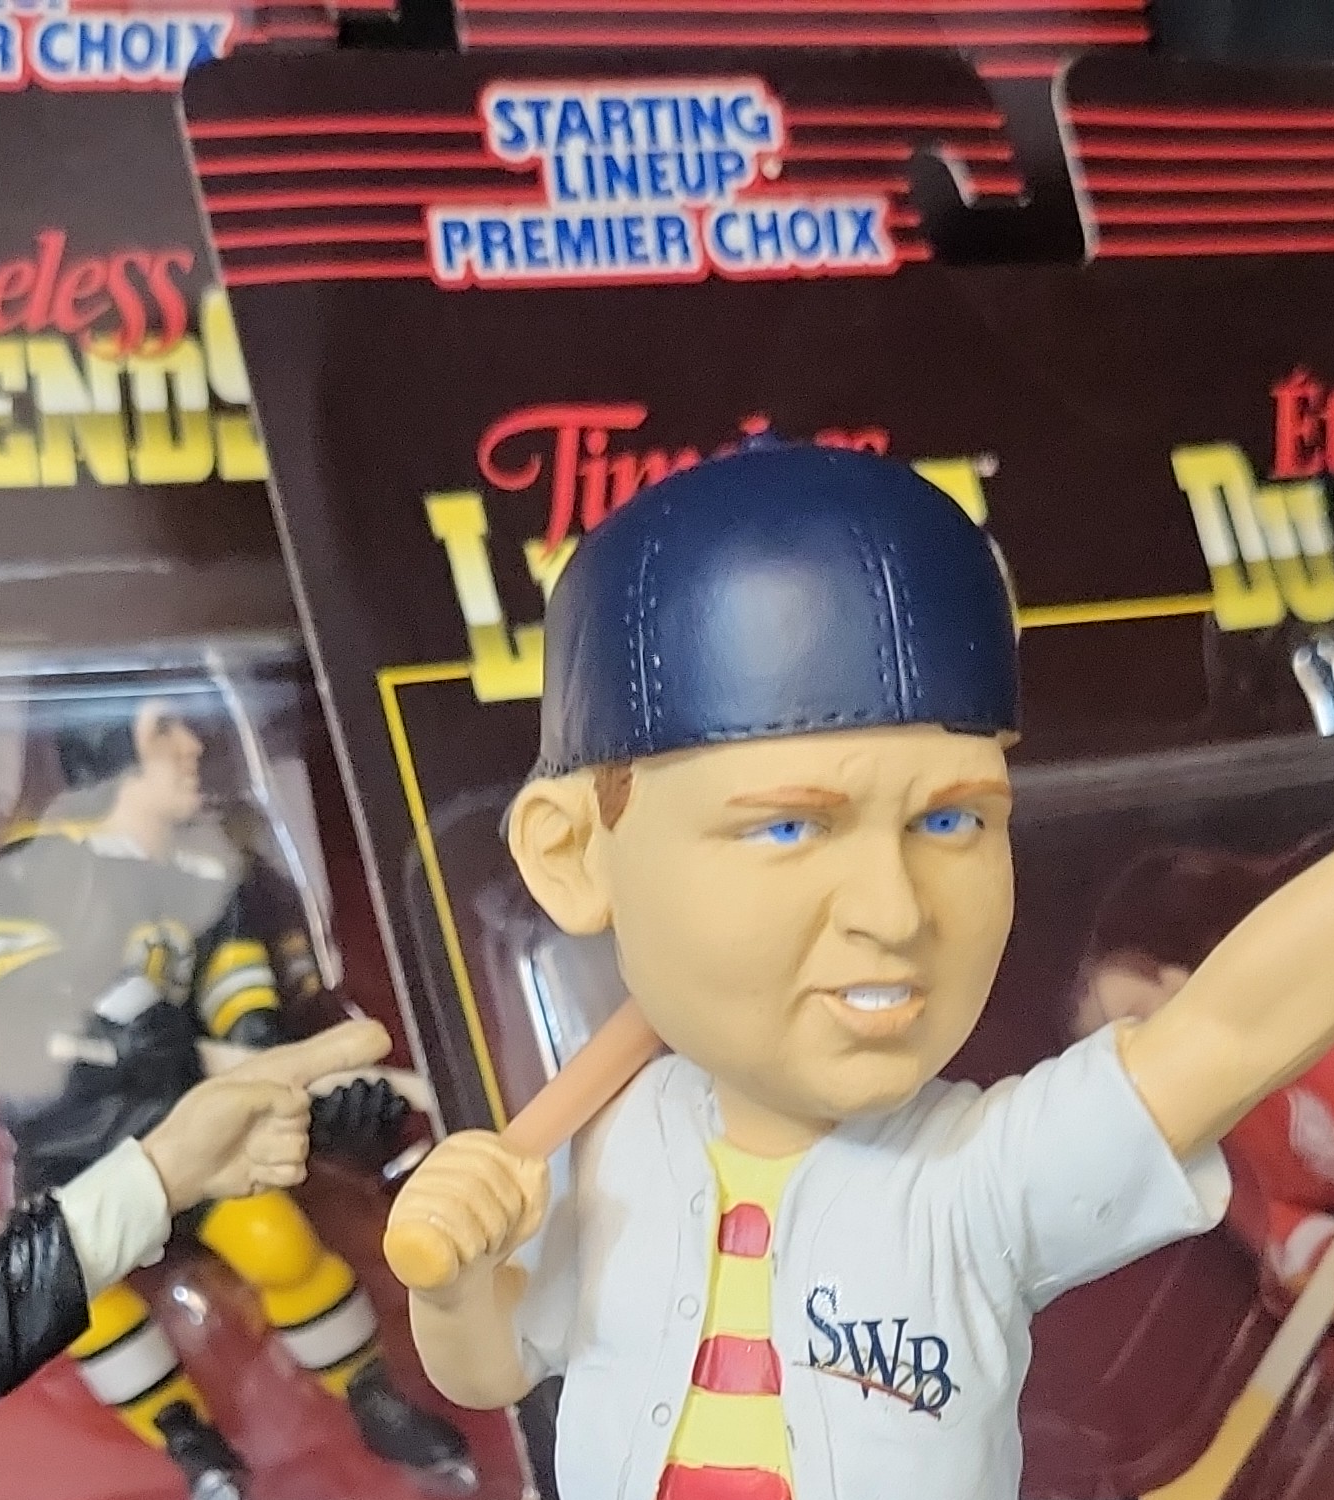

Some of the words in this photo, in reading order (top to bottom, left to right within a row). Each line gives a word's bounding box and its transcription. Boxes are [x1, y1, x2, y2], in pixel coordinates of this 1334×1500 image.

[37, 21, 223, 73] CHOIX
[491, 95, 770, 149] STARTING
[552, 148, 747, 200] LINEUP
[440, 214, 690, 270] PREMIER
[712, 207, 881, 260] CHOIX
[806, 1284, 956, 1416] SWB
